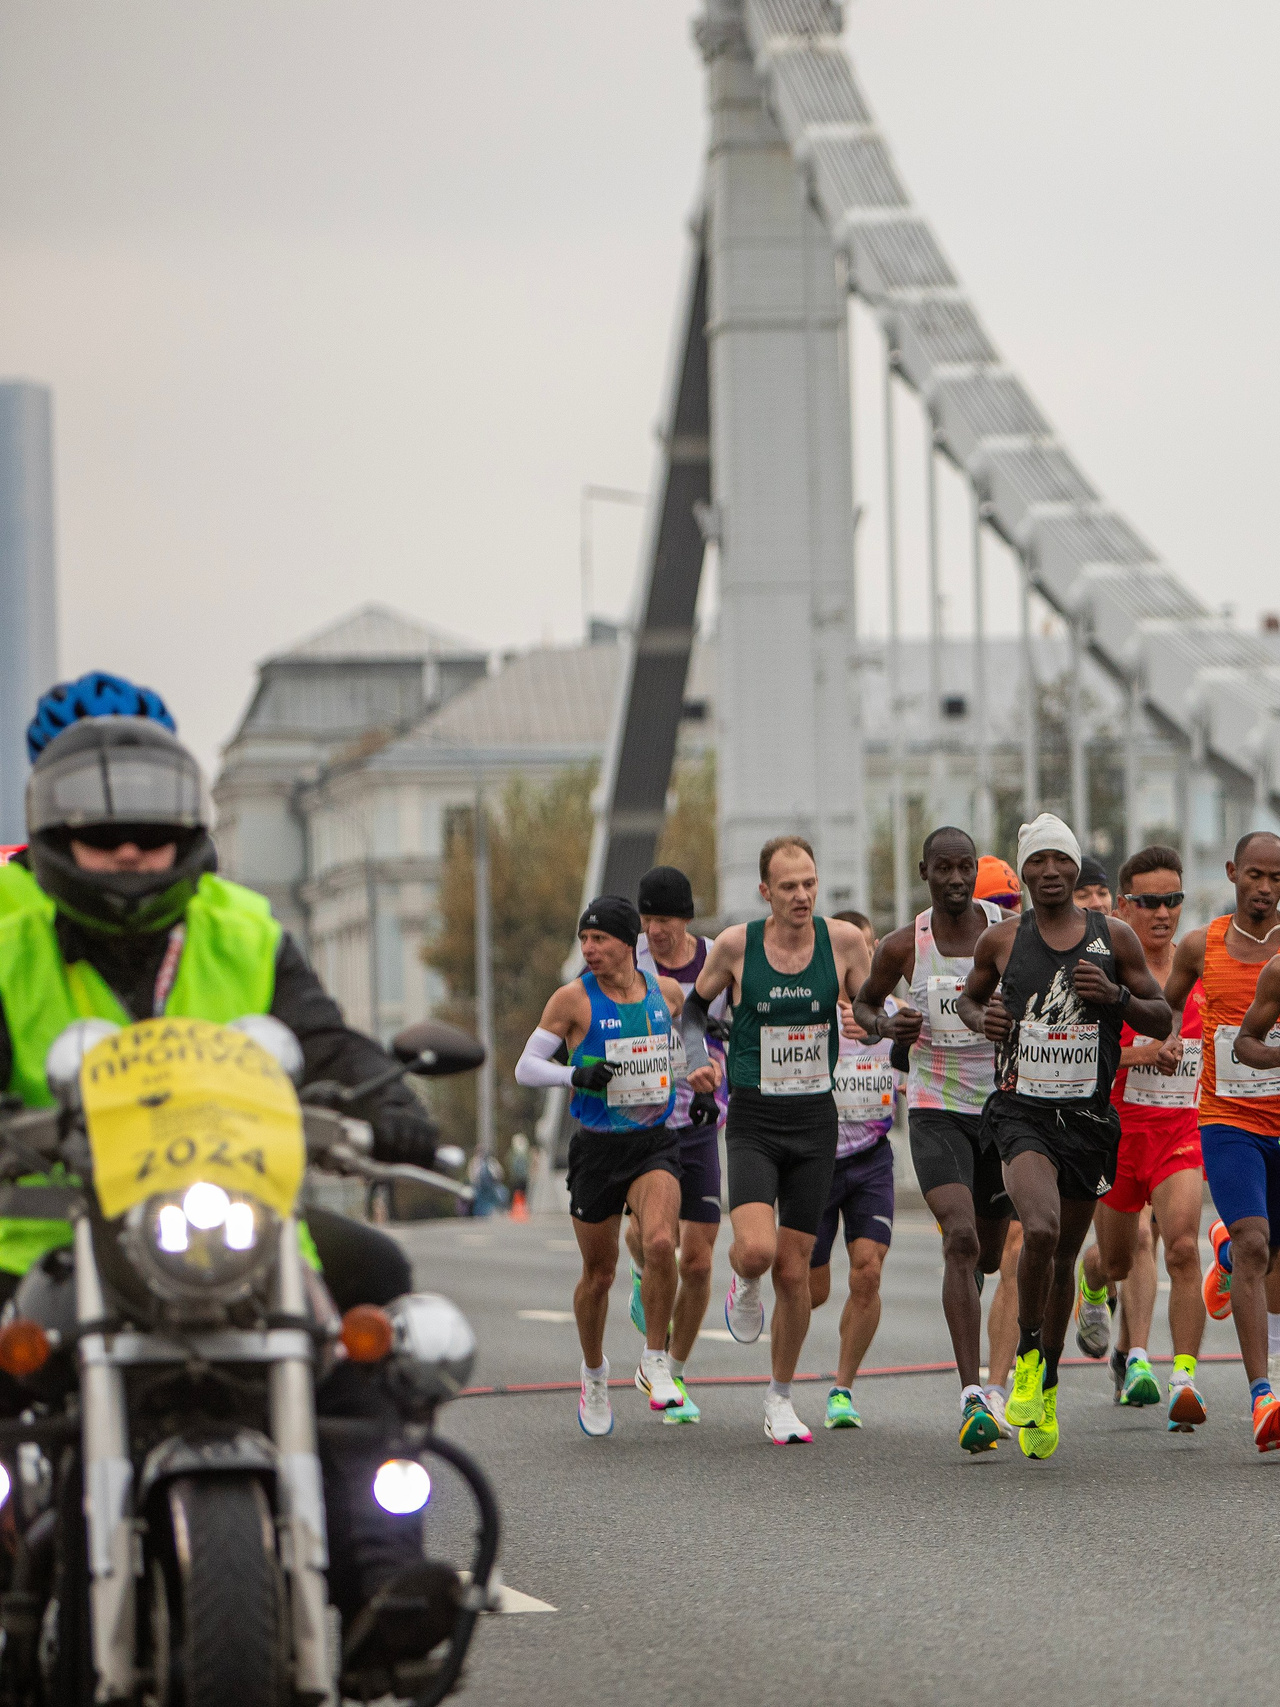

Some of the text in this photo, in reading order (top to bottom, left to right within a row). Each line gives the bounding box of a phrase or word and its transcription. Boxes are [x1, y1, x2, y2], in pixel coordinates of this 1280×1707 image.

[1086, 946, 1111, 956] adidas
[782, 986, 813, 999] Avito
[771, 1045, 821, 1066] ЦИБАК
[1019, 1045, 1098, 1065] MUNYWOKI
[834, 1075, 893, 1094] КУЗНЕЦОВ
[132, 1135, 267, 1183] 2024
